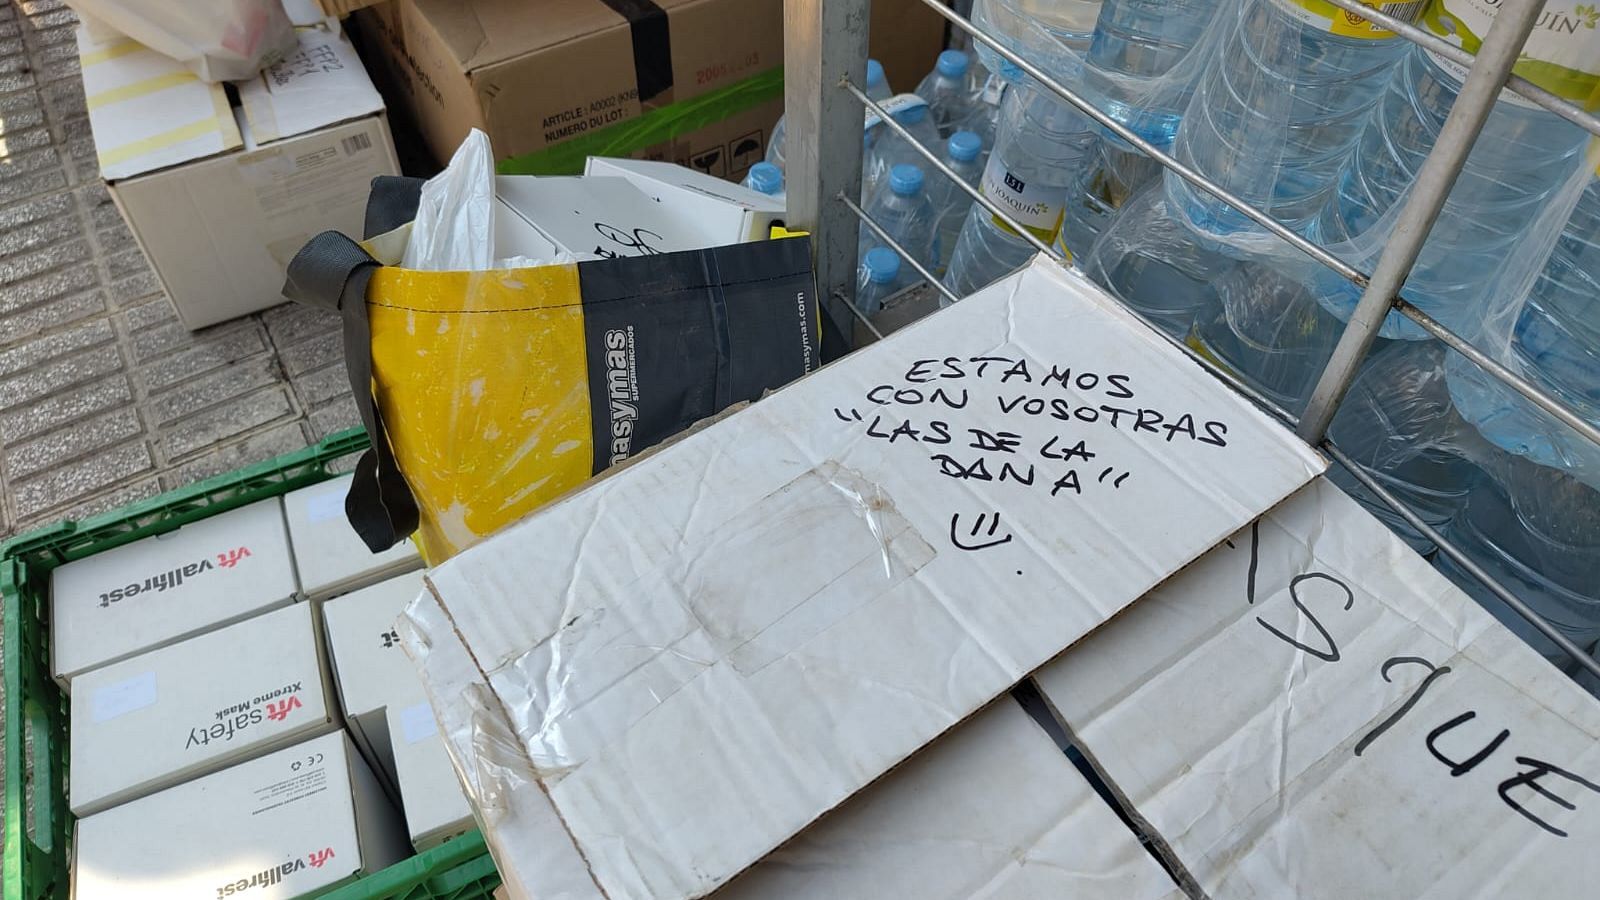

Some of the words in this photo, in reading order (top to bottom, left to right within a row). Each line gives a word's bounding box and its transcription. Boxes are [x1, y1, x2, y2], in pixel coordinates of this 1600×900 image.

[543, 107, 582, 128] ARTICLE
[544, 121, 588, 143] NUMERO
[588, 114, 604, 129] DU
[605, 108, 622, 123] LOT
[627, 324, 639, 402] SUPERMERCADOS
[904, 356, 1134, 399] ESTAMOS
[866, 385, 968, 409] CON
[997, 395, 1228, 447] VOSOTRAS
[967, 428, 1021, 453] DE
[1039, 435, 1096, 462] LA
[217, 546, 252, 568] vft
[97, 559, 214, 608] vallfirest
[215, 700, 250, 720] Mask
[253, 681, 302, 705] Xtreme
[266, 695, 303, 721] vft
[185, 708, 263, 751] safety
[308, 847, 335, 868] vft
[216, 858, 306, 900] vallfirest
